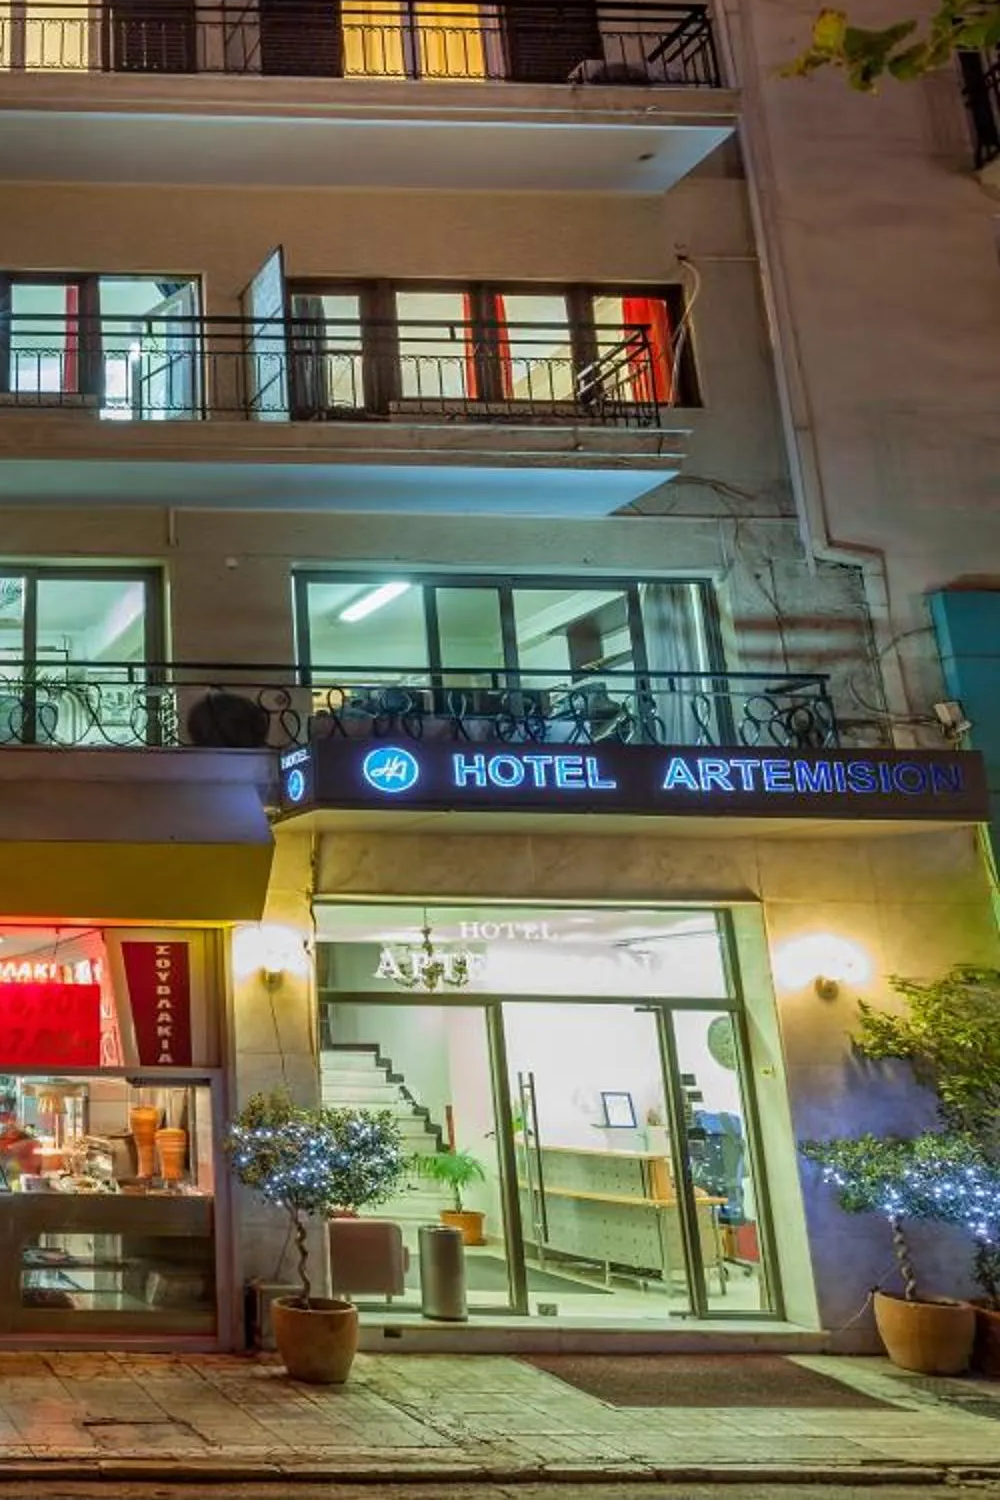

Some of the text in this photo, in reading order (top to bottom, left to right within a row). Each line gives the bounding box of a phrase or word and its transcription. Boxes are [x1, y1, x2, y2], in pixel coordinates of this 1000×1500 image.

[454, 754, 963, 793] HOTEL ARTEMISION
[458, 921, 558, 941] HOTEL
